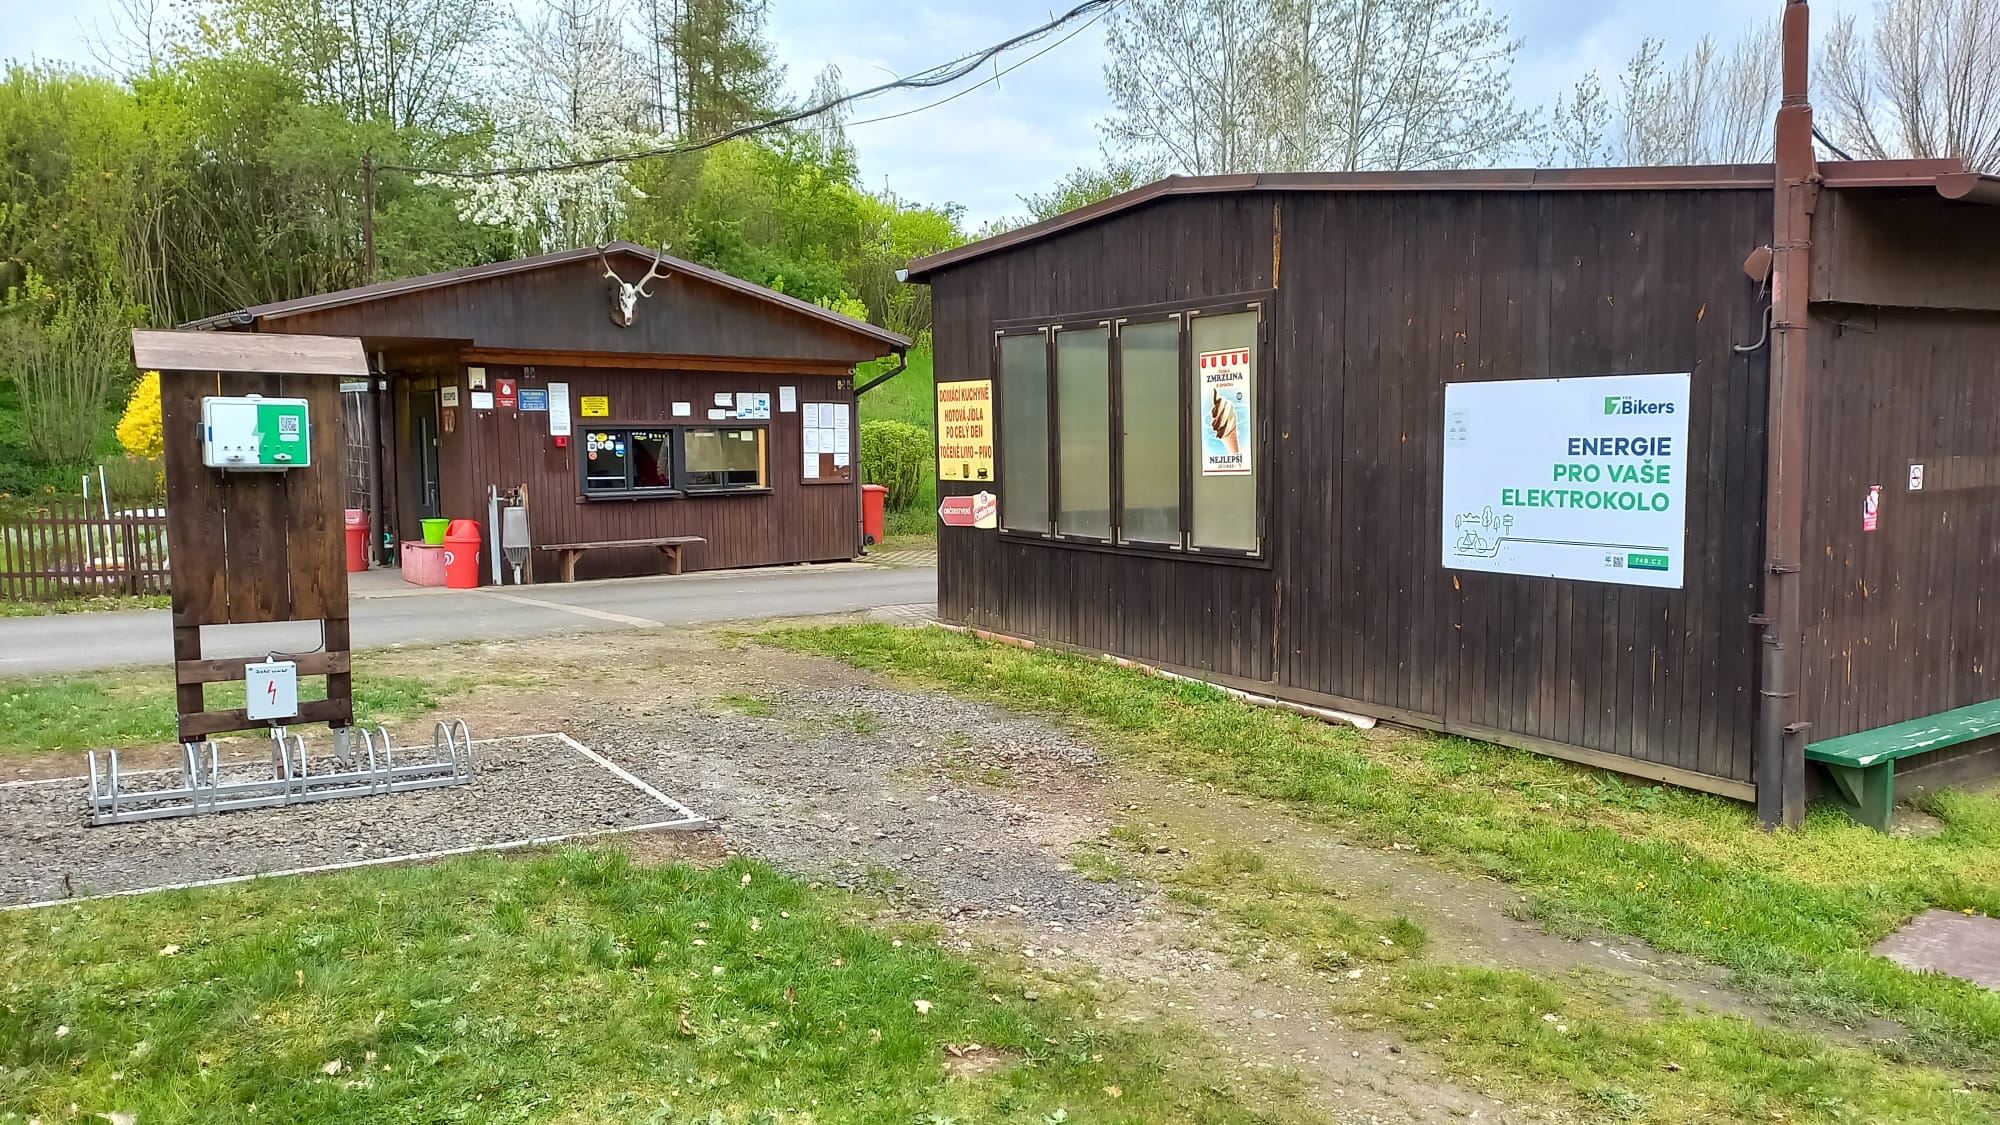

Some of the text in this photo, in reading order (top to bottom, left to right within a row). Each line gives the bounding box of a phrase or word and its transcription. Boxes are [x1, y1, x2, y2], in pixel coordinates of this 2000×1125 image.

[1207, 372, 1243, 383] ZMRZLINA
[939, 383, 989, 402] DOMÁCÍ KUCHYNĚ
[945, 404, 984, 422] HOTOVÁ JÍDLA
[1622, 399, 1675, 414] Bikers
[946, 422, 983, 439] PO CELÝ DEN
[940, 443, 960, 459] TOČENÉ
[960, 445, 974, 459] LIMO
[979, 445, 992, 459] PIVO
[1568, 437, 1672, 456] ENERGIE
[1209, 453, 1243, 464] NEJLEPŠÍ
[1553, 459, 1671, 484] PRO VAŠE
[1501, 488, 1670, 512] ELEKTROKOLO
